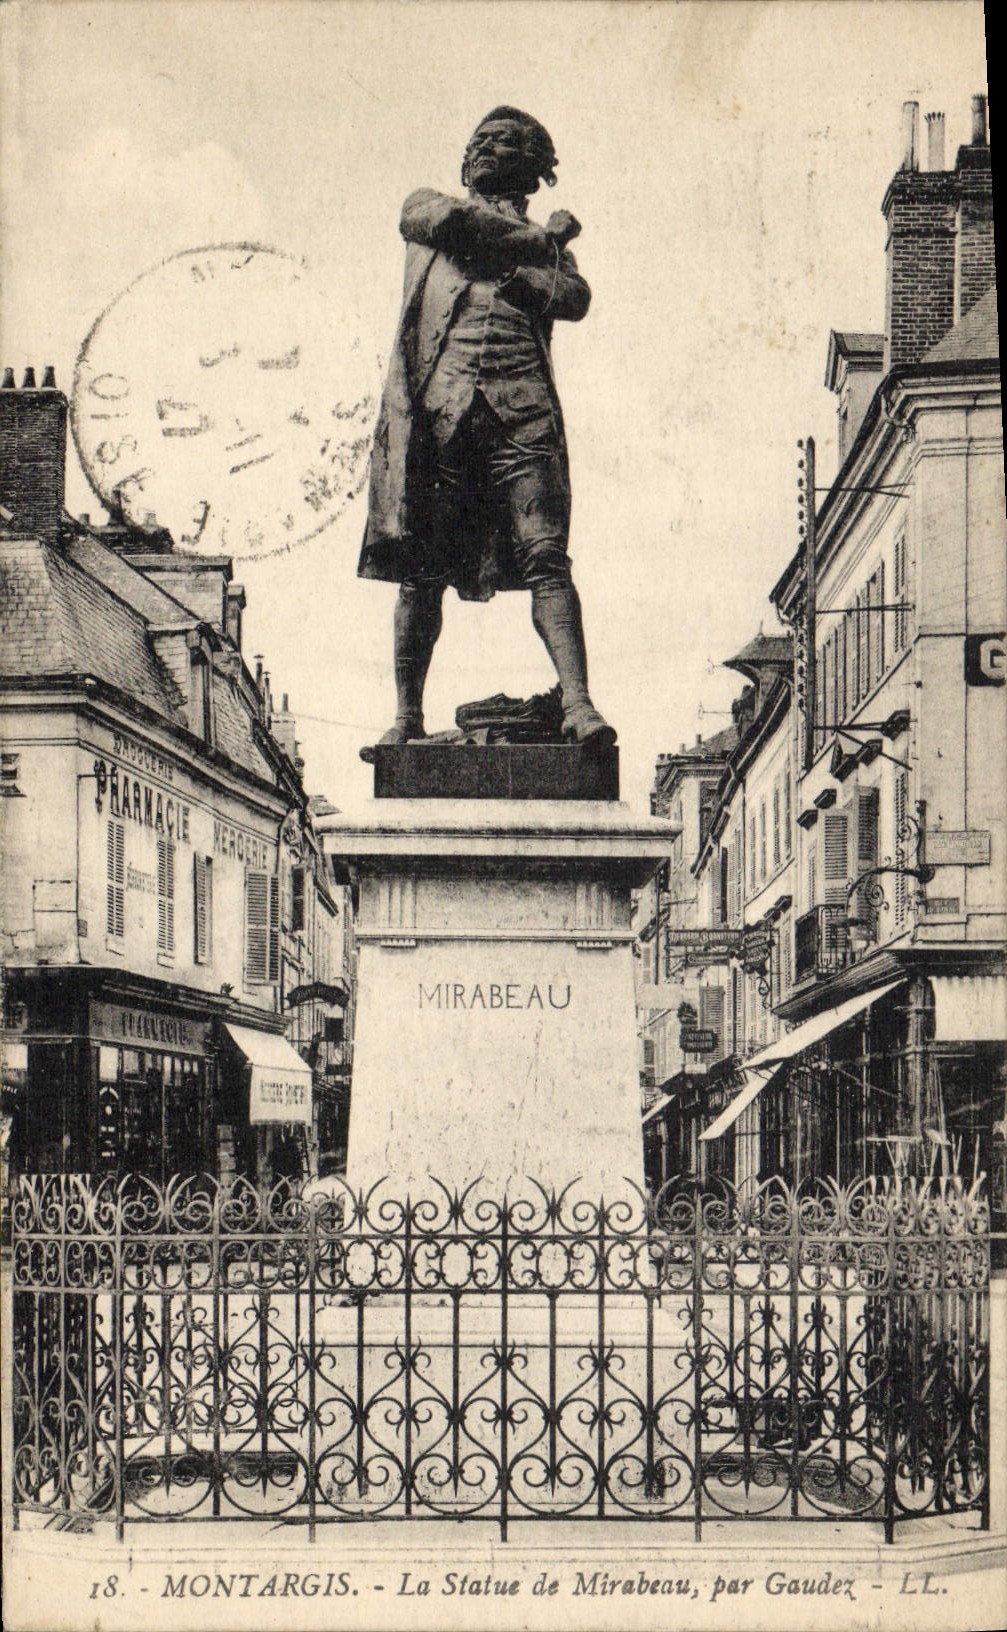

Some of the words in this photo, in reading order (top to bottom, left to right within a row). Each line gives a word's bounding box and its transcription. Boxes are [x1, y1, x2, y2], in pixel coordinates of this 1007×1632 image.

[95, 760, 190, 843] PHARMACIE
[213, 820, 268, 870] MERCERIE
[418, 983, 572, 1010] MIRABEAU
